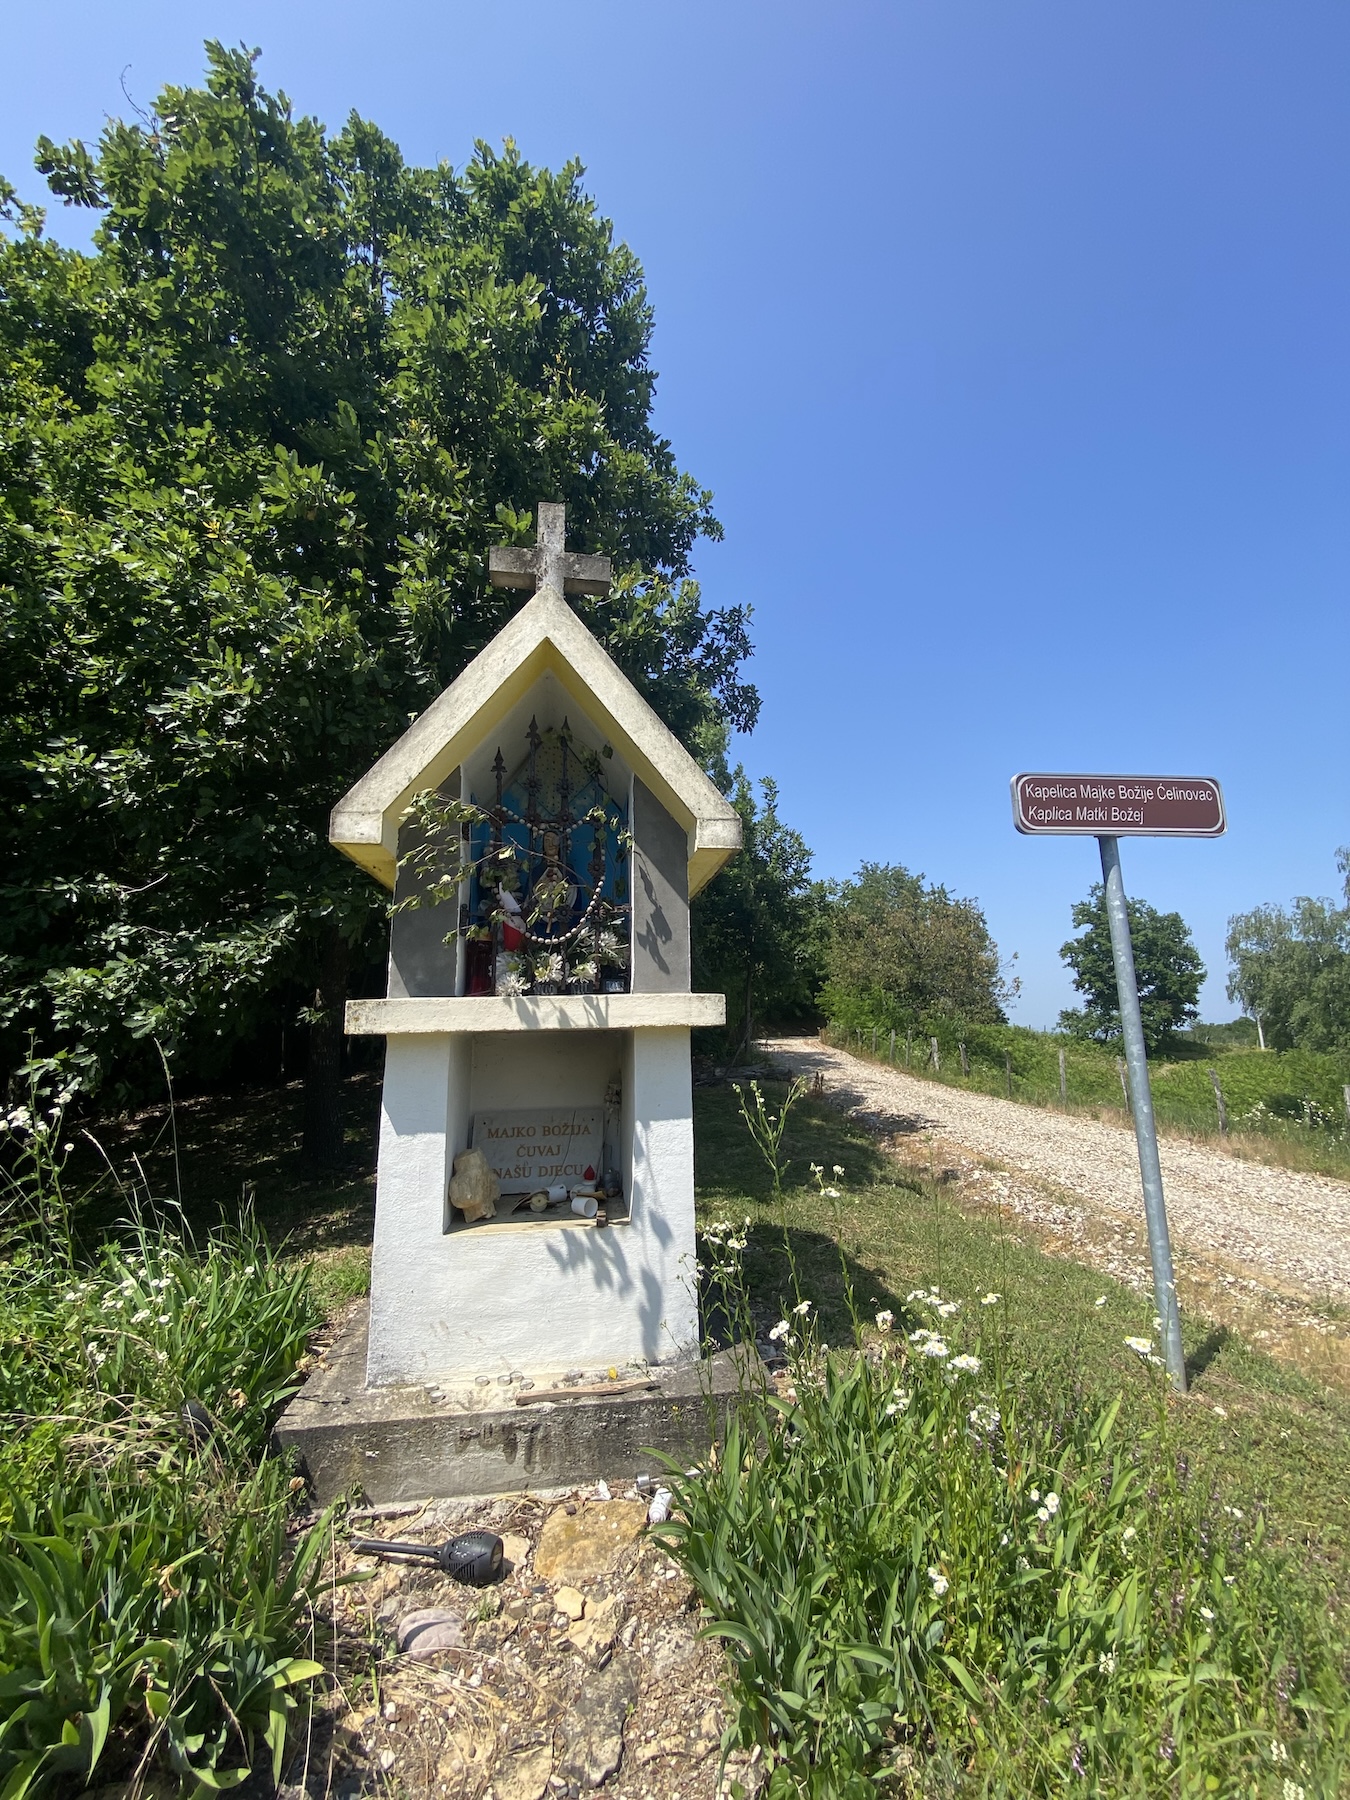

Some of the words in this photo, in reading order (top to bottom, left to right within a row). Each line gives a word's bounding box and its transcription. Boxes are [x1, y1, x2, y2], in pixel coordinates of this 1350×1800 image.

[1025, 783, 1077, 801] Kapelica
[1080, 785, 1115, 803] Majke
[1119, 785, 1154, 803] Božije
[1028, 806, 1072, 823] Kaplica
[1076, 807, 1107, 821] Matki
[1111, 808, 1144, 824] Božej
[487, 1126, 536, 1139] MAJKO
[543, 1122, 591, 1136] BOŽIJA
[516, 1144, 561, 1157] ČUVAJ
[492, 1164, 532, 1179] NAŠU
[538, 1164, 583, 1178] DJECU
